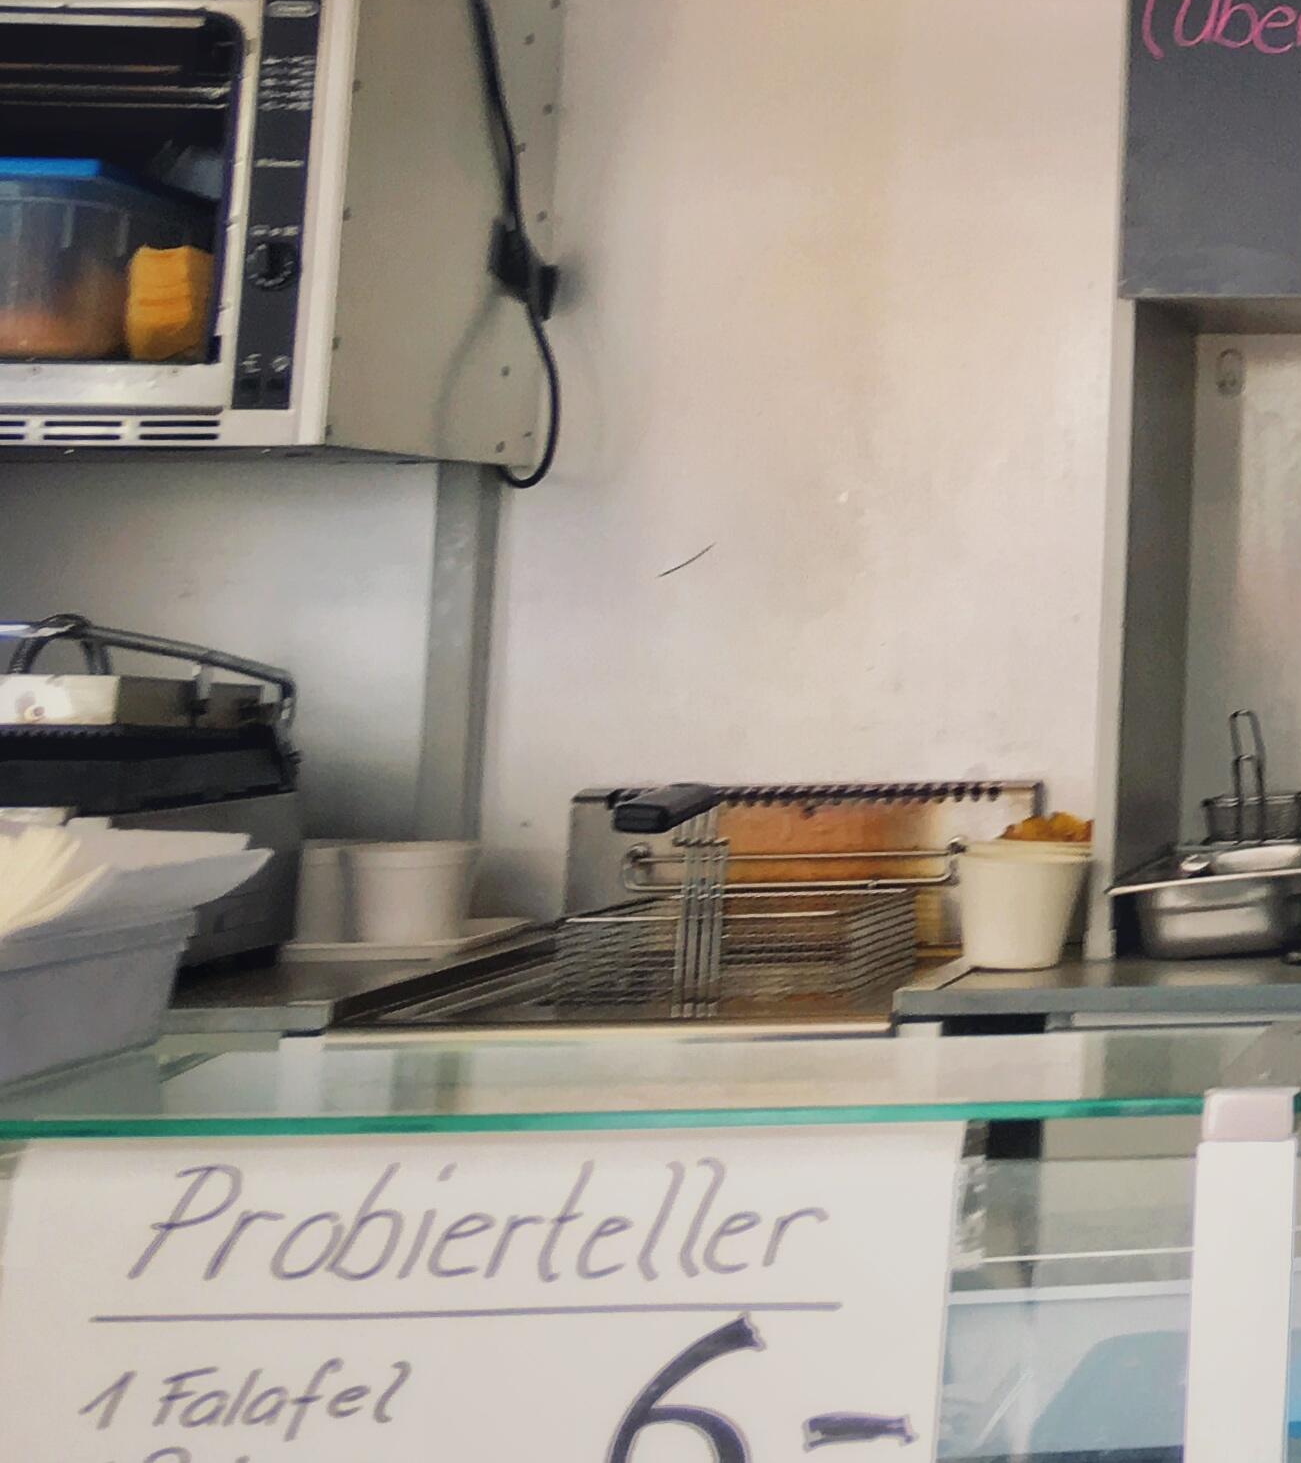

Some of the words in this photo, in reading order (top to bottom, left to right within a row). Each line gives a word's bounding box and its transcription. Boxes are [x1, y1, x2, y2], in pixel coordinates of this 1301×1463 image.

[128, 1157, 829, 1284] Probierteller
[78, 1370, 137, 1430] 1
[152, 1357, 412, 1442] Falafel
